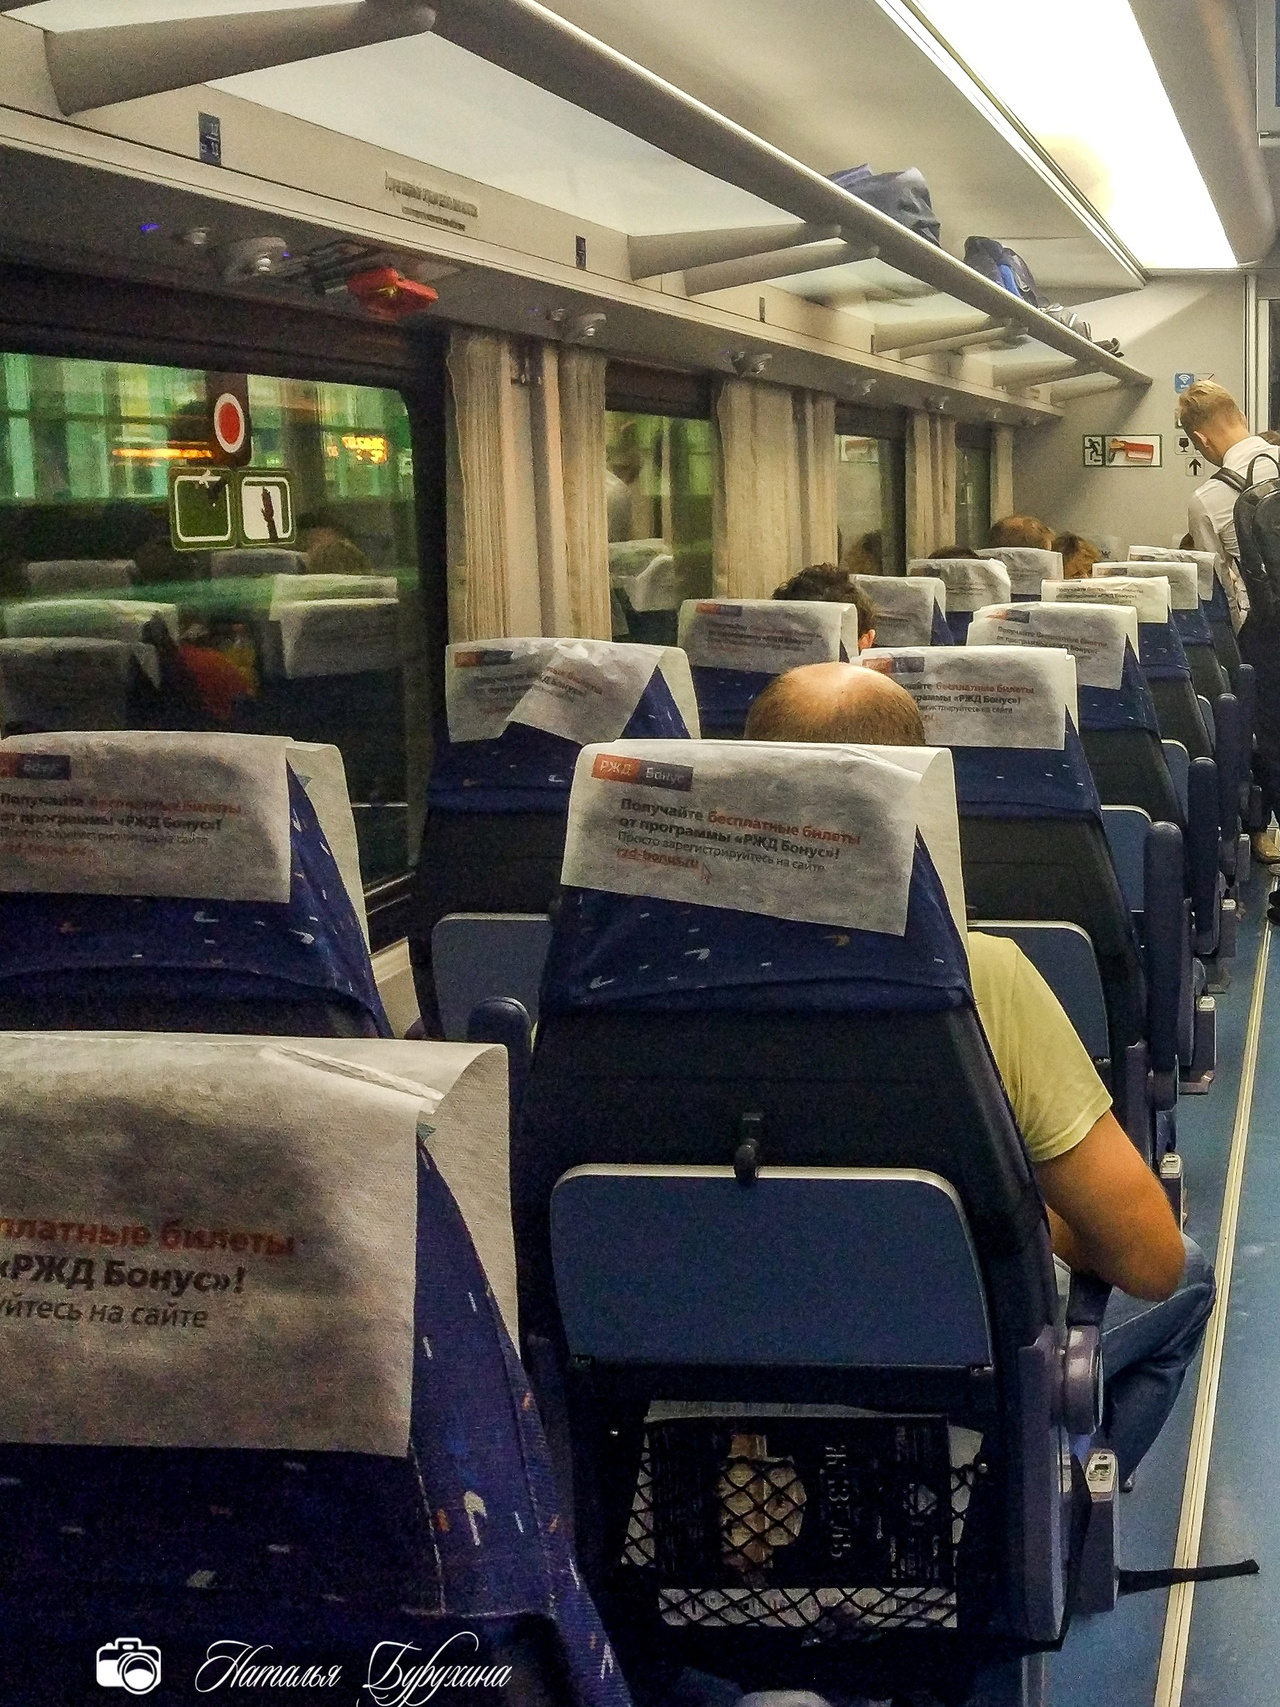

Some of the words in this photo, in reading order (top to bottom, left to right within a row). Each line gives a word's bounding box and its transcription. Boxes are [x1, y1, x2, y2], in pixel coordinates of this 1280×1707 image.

[598, 758, 635, 776] РЖД
[644, 767, 686, 786] Бонус
[619, 817, 637, 828] от
[639, 820, 732, 843] программы
[734, 833, 778, 852] «РЖД
[780, 840, 841, 860] Бонус»!
[620, 798, 704, 820] Получайте
[707, 810, 800, 836] бесплатные
[802, 825, 862, 846] билеты
[617, 830, 660, 846] Просто
[776, 858, 790, 867] на
[791, 860, 825, 872] сайте
[160, 1217, 295, 1256] билеты
[103, 1259, 248, 1297] Бонус»!
[0, 1290, 83, 1322] йтесь
[90, 1303, 124, 1325] на
[130, 1301, 210, 1328] сайте
